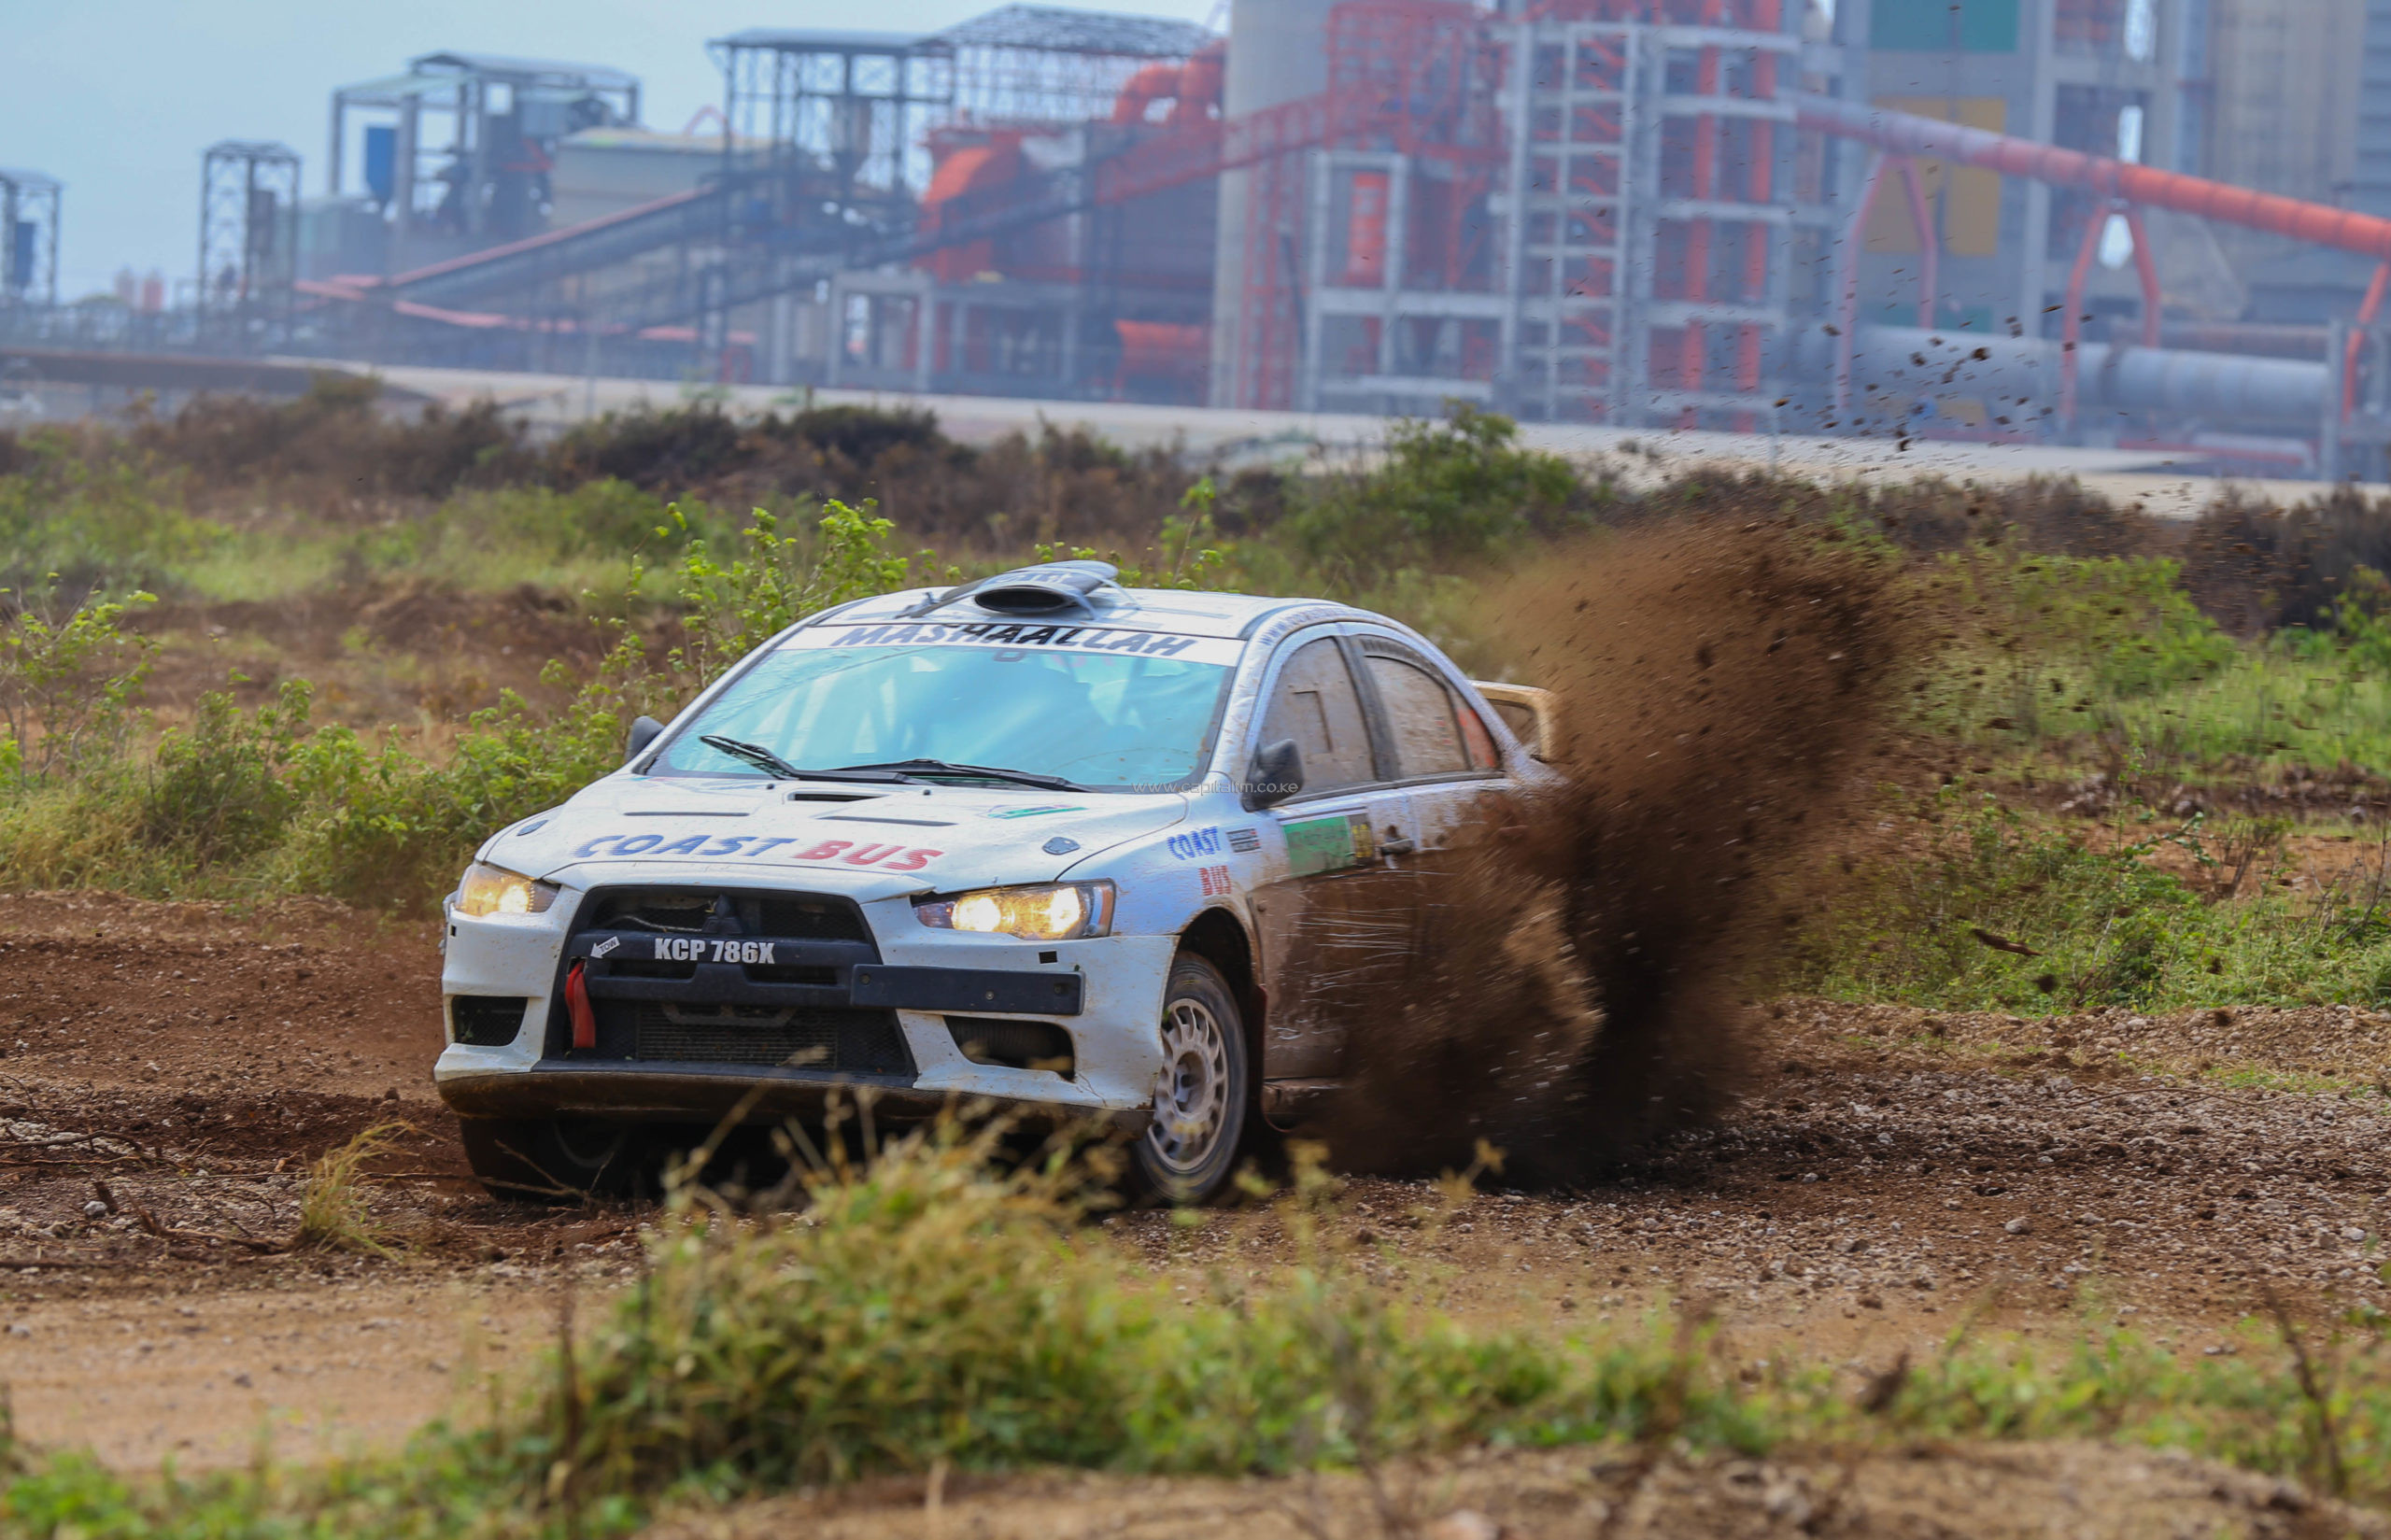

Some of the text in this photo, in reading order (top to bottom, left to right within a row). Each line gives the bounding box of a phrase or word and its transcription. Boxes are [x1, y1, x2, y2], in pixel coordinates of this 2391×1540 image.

[829, 623, 1198, 657] MASHAALLAH
[569, 834, 945, 870] COAST BUS
[1167, 826, 1222, 860] COAST
[1198, 865, 1232, 897] BUS
[599, 938, 617, 953] TOW
[655, 938, 775, 965] KCP 786X
